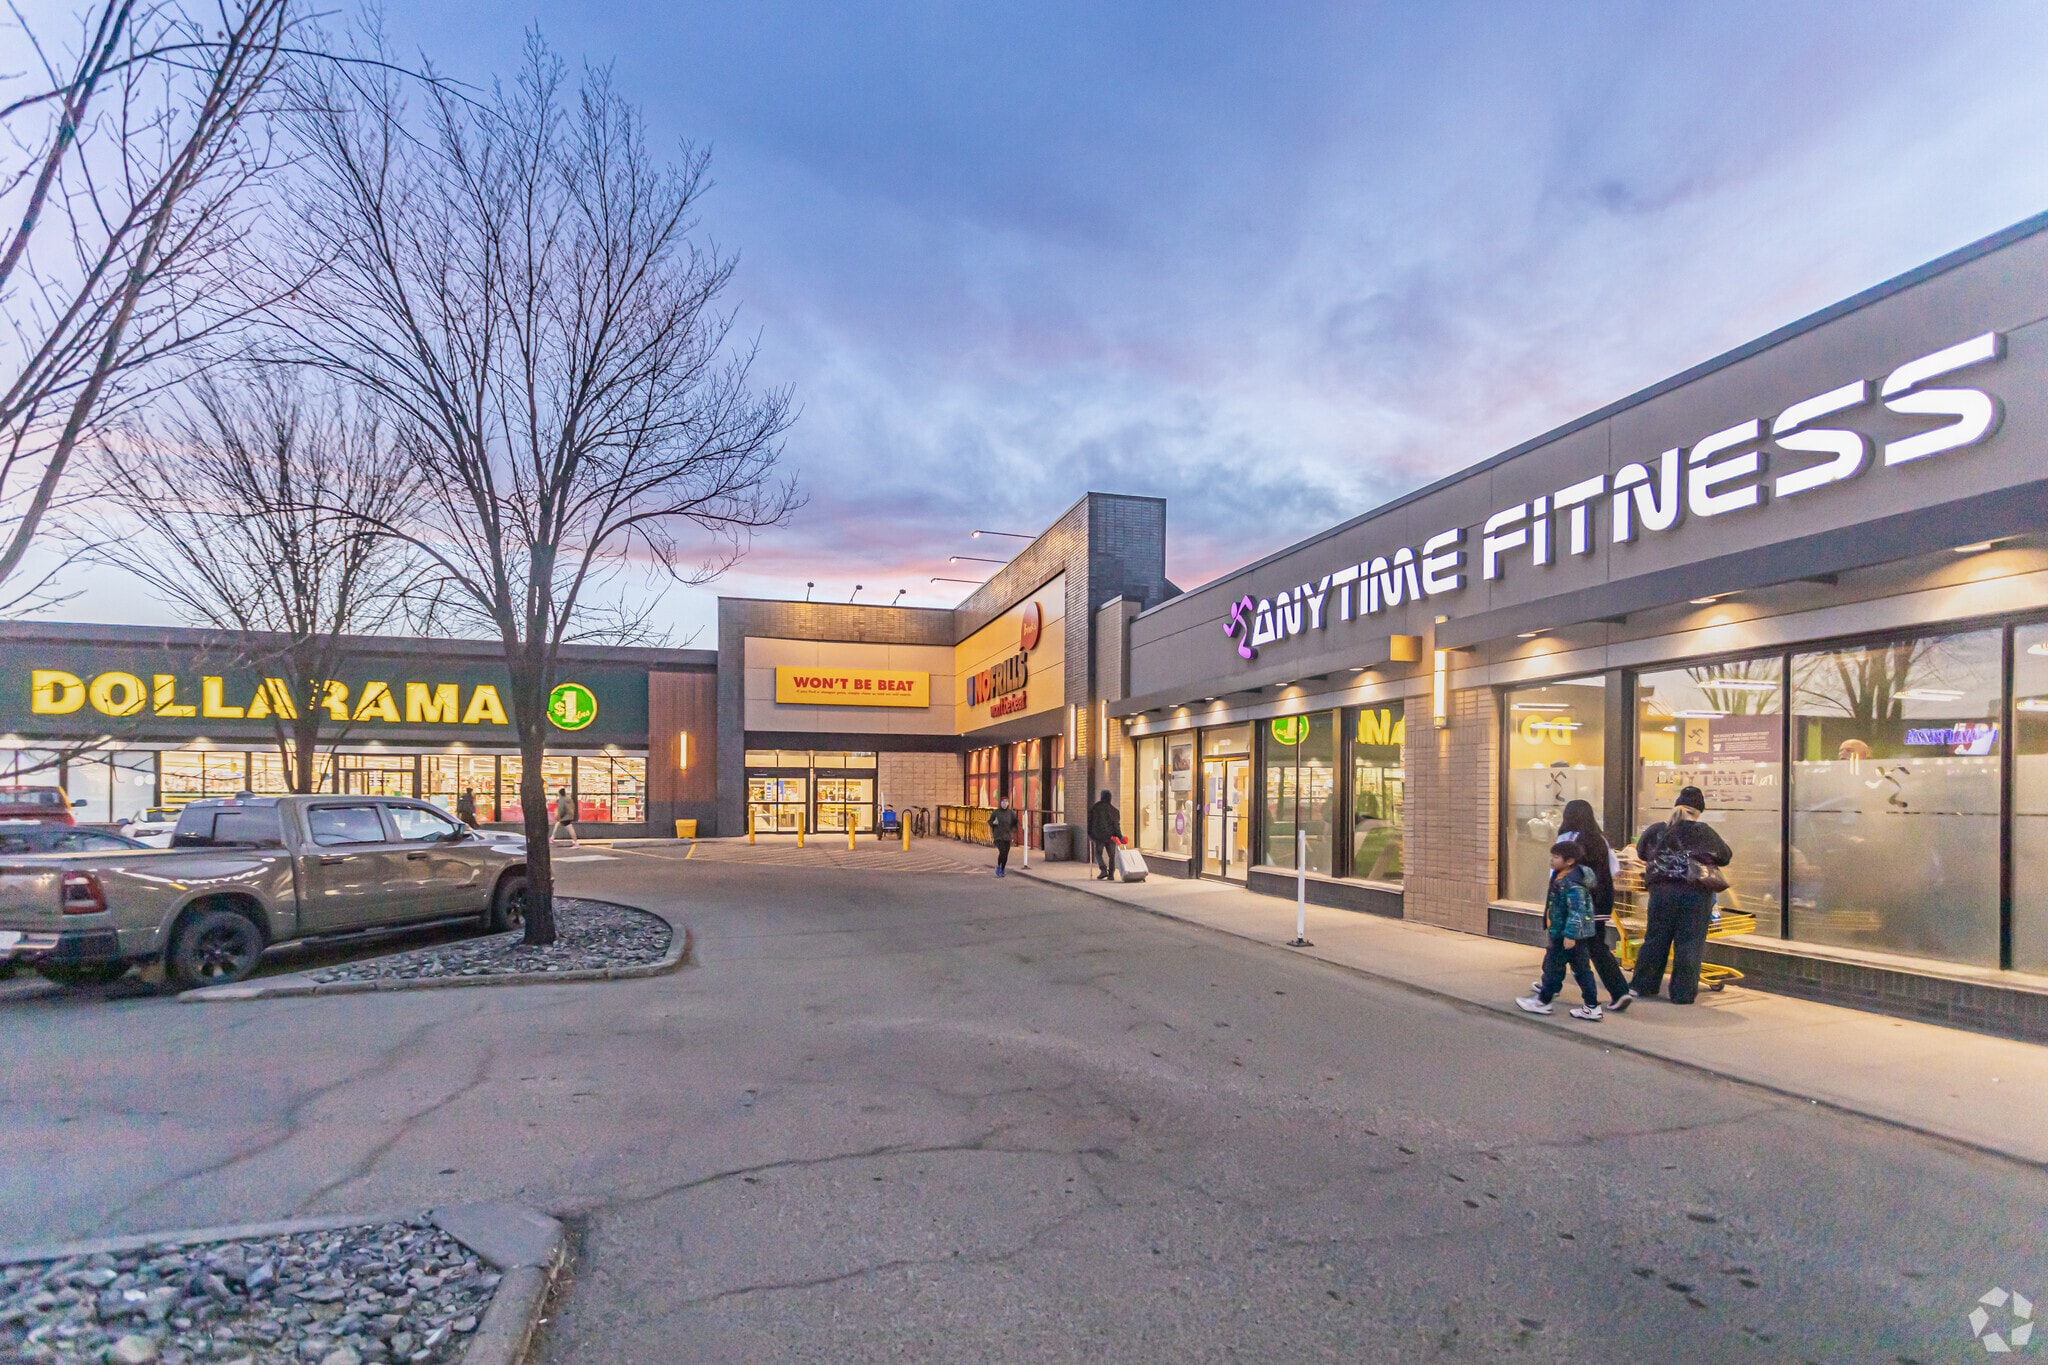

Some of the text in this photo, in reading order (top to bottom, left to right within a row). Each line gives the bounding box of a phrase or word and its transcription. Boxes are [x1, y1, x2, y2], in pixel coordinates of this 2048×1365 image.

[1251, 331, 1997, 647] ANYTIME FITNESS
[32, 669, 509, 725] DOLLARAMA
[793, 676, 914, 692] WON'T BE BEAT
